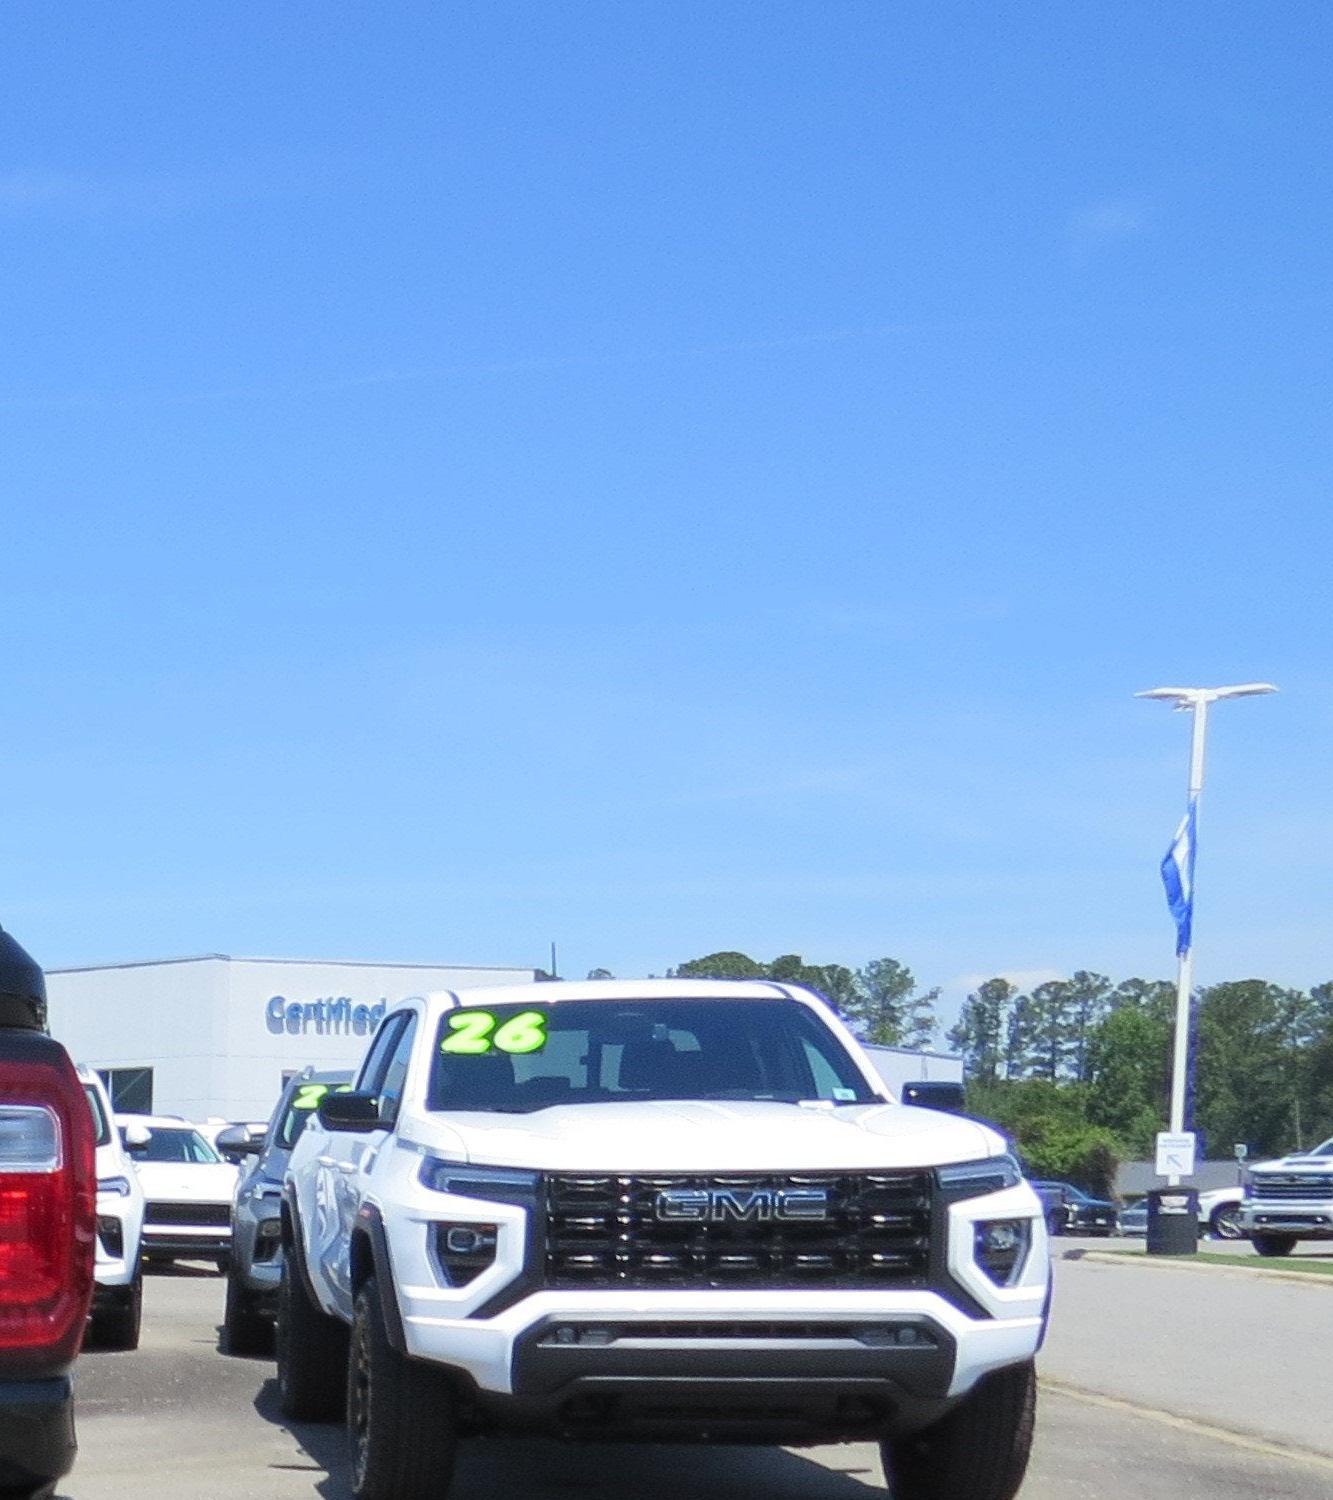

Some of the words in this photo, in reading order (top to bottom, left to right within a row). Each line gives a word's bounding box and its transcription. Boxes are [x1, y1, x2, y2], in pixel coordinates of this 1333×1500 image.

[266, 996, 387, 1023] Certified
[440, 1010, 546, 1053] 26
[655, 1190, 827, 1221] GMC
